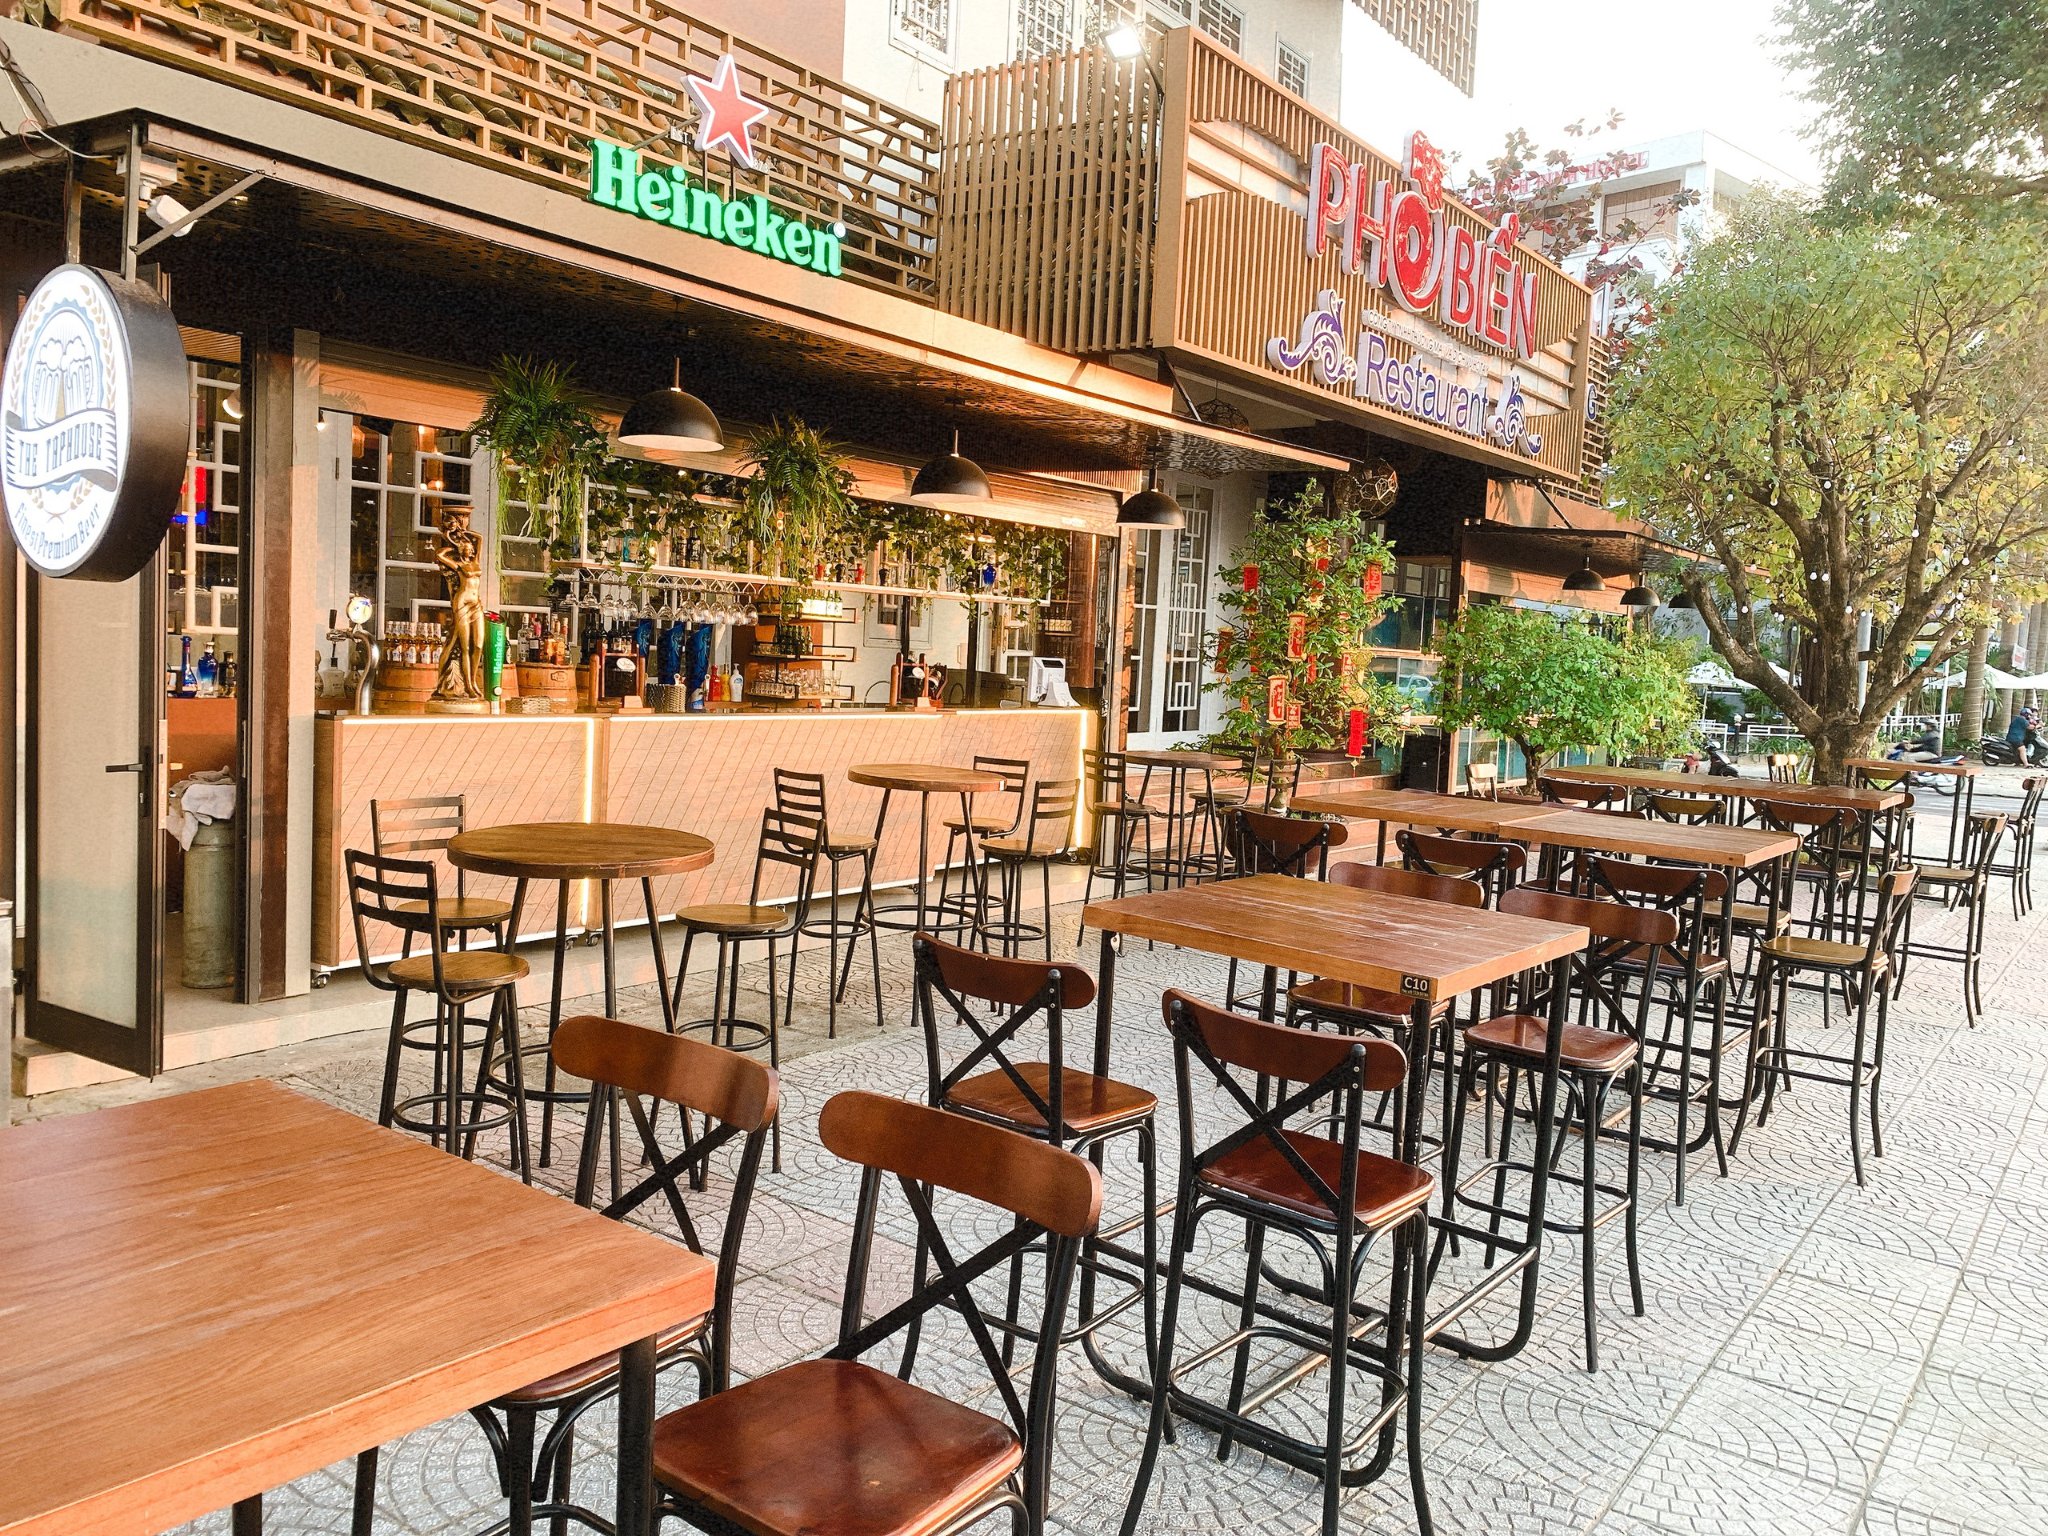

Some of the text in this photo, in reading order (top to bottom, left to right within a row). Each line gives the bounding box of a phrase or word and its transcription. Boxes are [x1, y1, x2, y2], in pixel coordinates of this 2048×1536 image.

[588, 138, 843, 277] Heineken
[1362, 332, 1490, 438] Restaurant
[18, 422, 103, 477] THE TAPHOUSE
[14, 502, 100, 560] Finest Premium Beer
[493, 630, 504, 674] Heineken
[1404, 976, 1428, 992] C10
